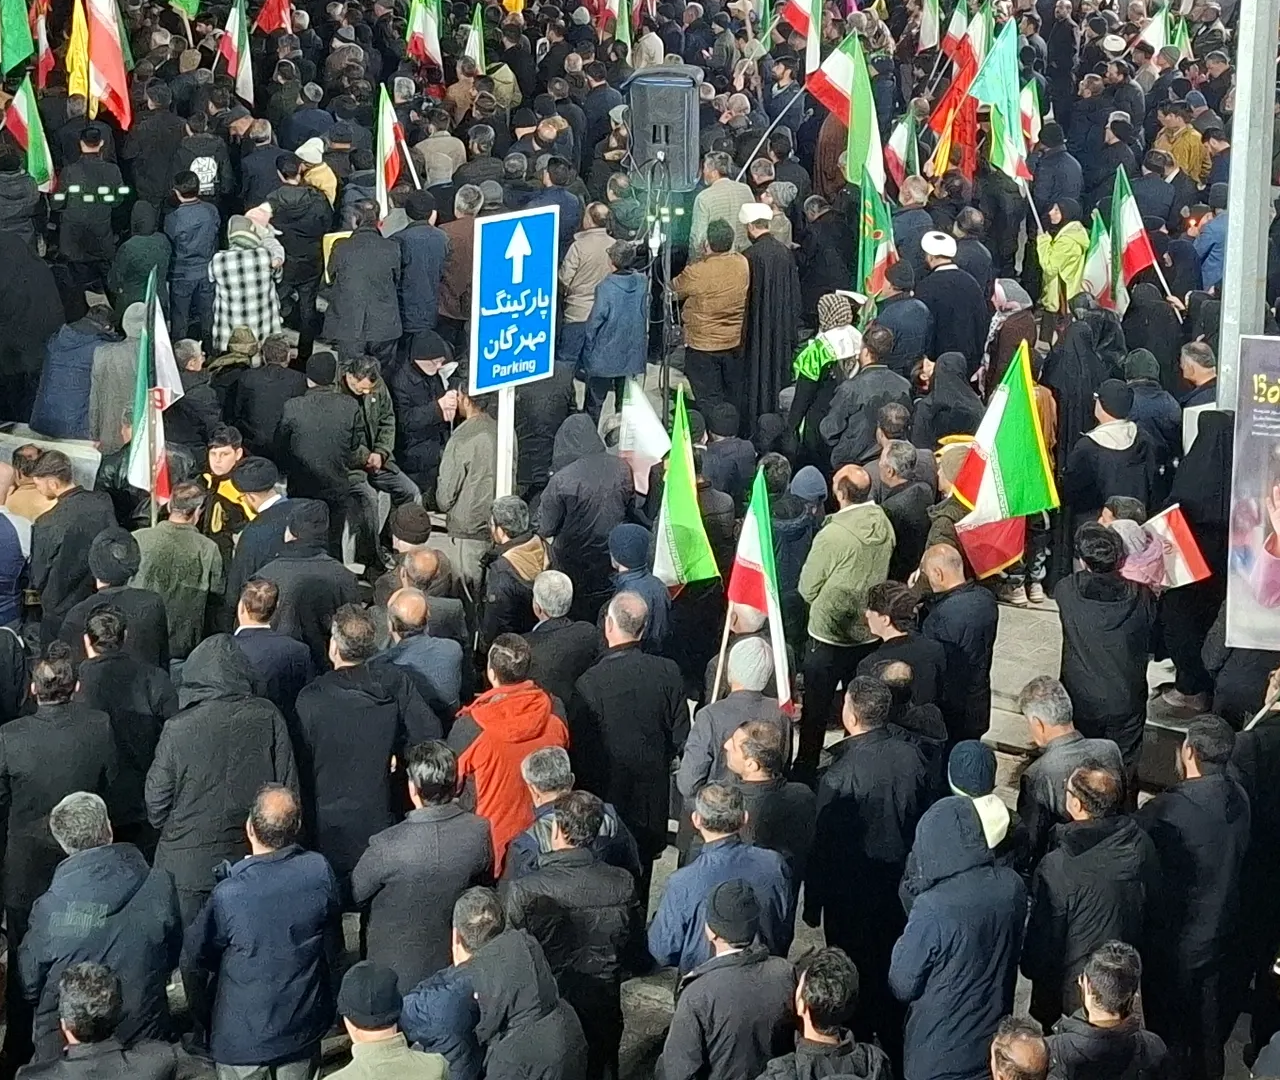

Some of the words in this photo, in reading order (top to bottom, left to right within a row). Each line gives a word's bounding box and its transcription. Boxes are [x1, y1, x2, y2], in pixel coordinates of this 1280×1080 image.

[481, 288, 550, 319] پارکینگ
[483, 324, 546, 360] مهرگان
[492, 359, 536, 378] Parking
